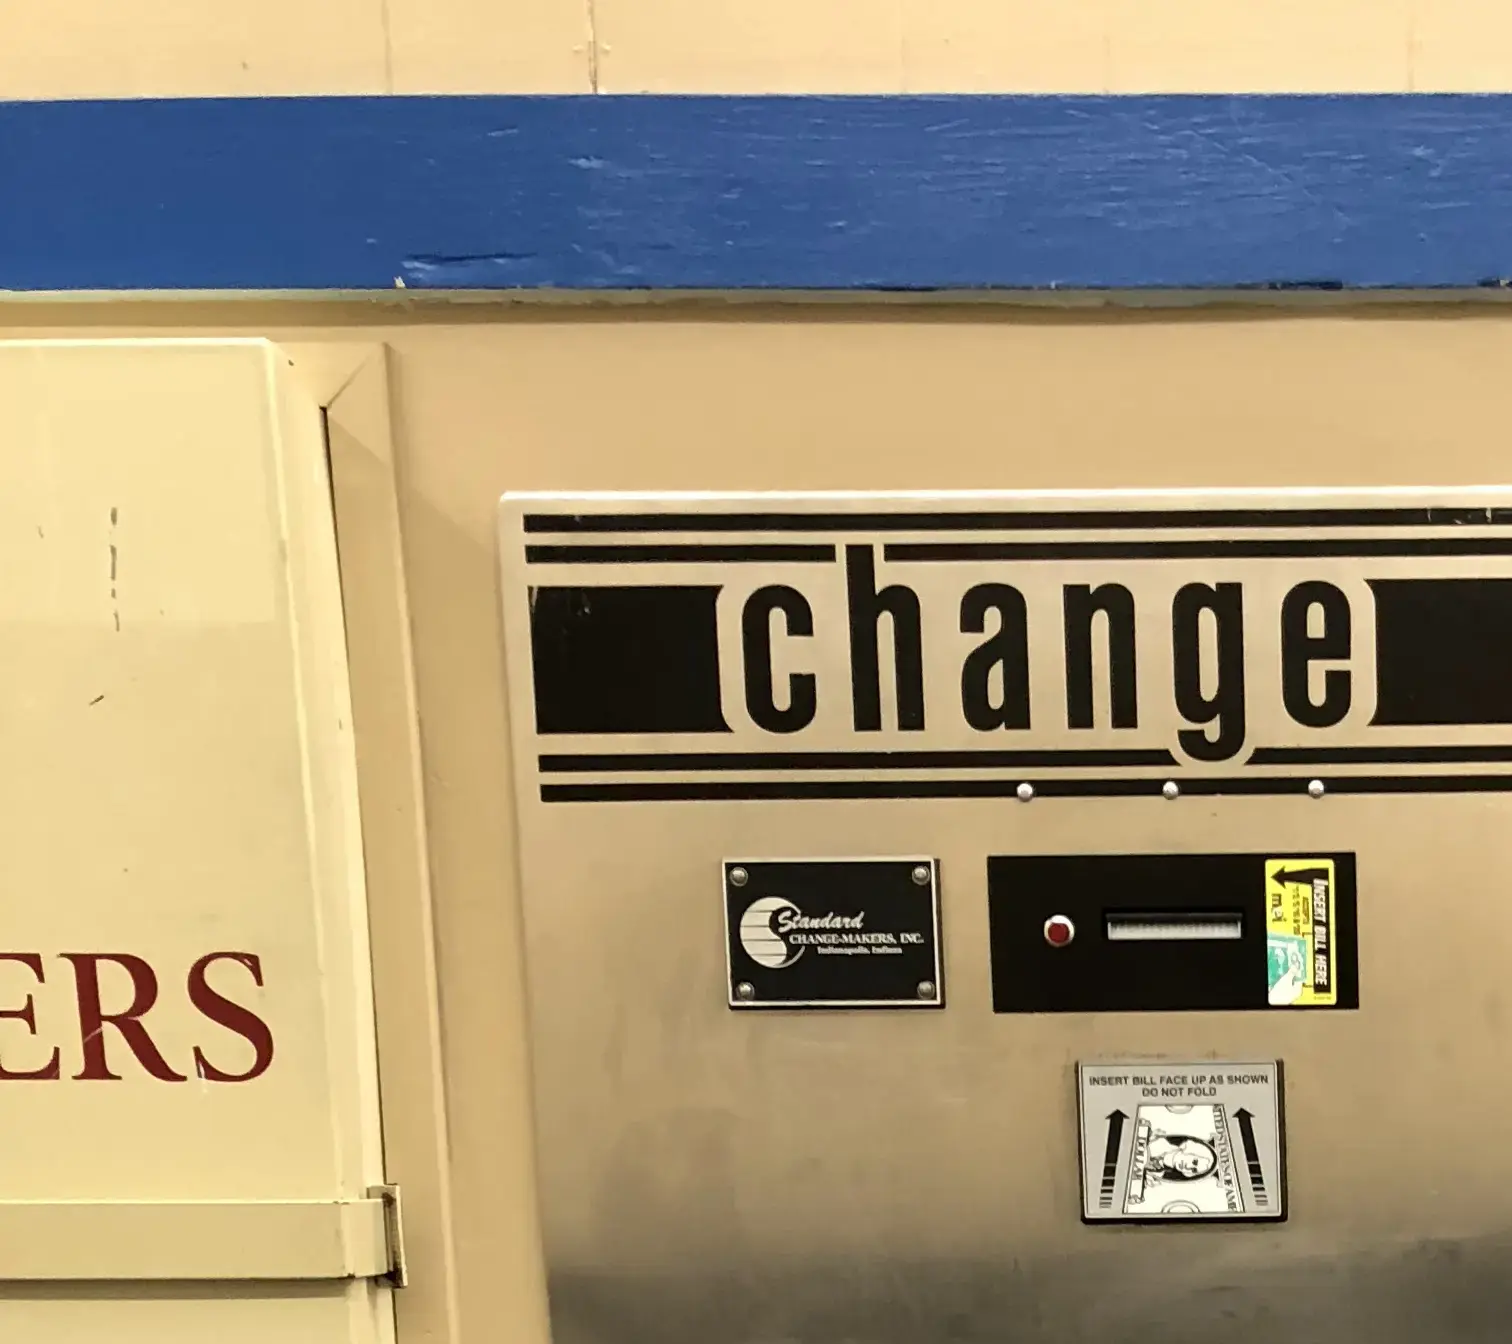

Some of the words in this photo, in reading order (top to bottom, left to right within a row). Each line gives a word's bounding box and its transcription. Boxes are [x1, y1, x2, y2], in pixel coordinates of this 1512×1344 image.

[742, 544, 1352, 762] change
[1313, 878, 1328, 923] INSERT
[778, 910, 865, 933] Standard
[900, 933, 924, 944] INC.
[1314, 925, 1327, 950] BILL
[1315, 954, 1327, 986] HERE
[1089, 1076, 1129, 1086] INSERT
[1132, 1075, 1156, 1086] BILL
[1159, 1075, 1188, 1085] FACE
[1191, 1075, 1207, 1085] UP
[1209, 1075, 1224, 1085] AS
[1227, 1075, 1269, 1085] SHOWN
[1142, 1087, 1158, 1097] DO
[1161, 1087, 1184, 1097] NOT
[1187, 1086, 1217, 1097] FOLD
